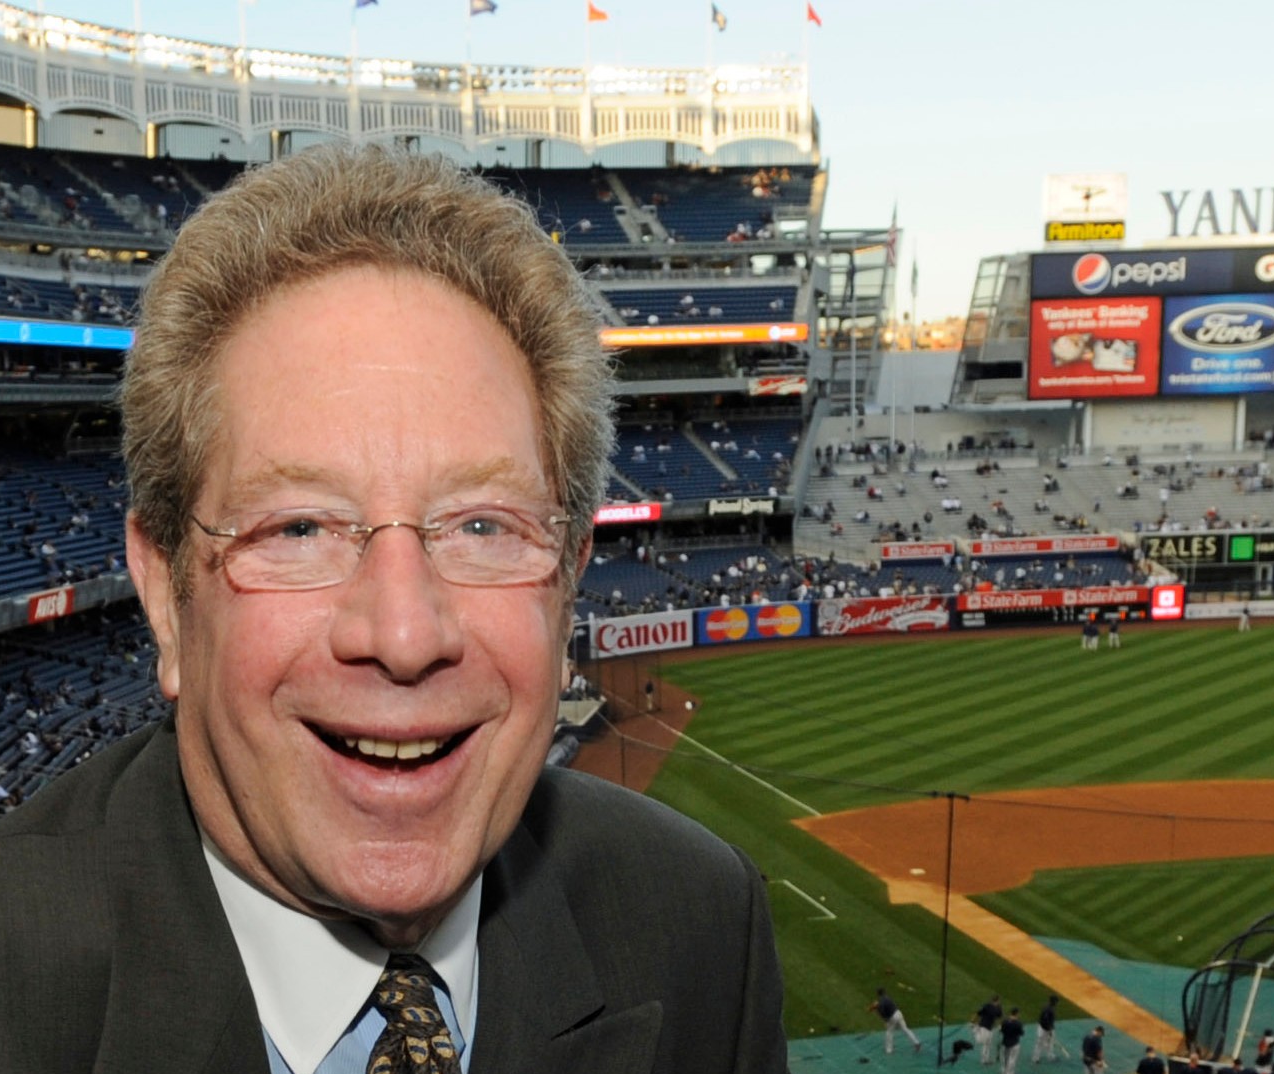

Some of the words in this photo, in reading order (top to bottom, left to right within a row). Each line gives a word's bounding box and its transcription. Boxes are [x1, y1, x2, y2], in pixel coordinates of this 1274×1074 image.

[1111, 257, 1187, 289] pepsi
[1195, 312, 1263, 344] Ford
[1148, 536, 1217, 557] ZALES
[596, 620, 688, 652] Canon
